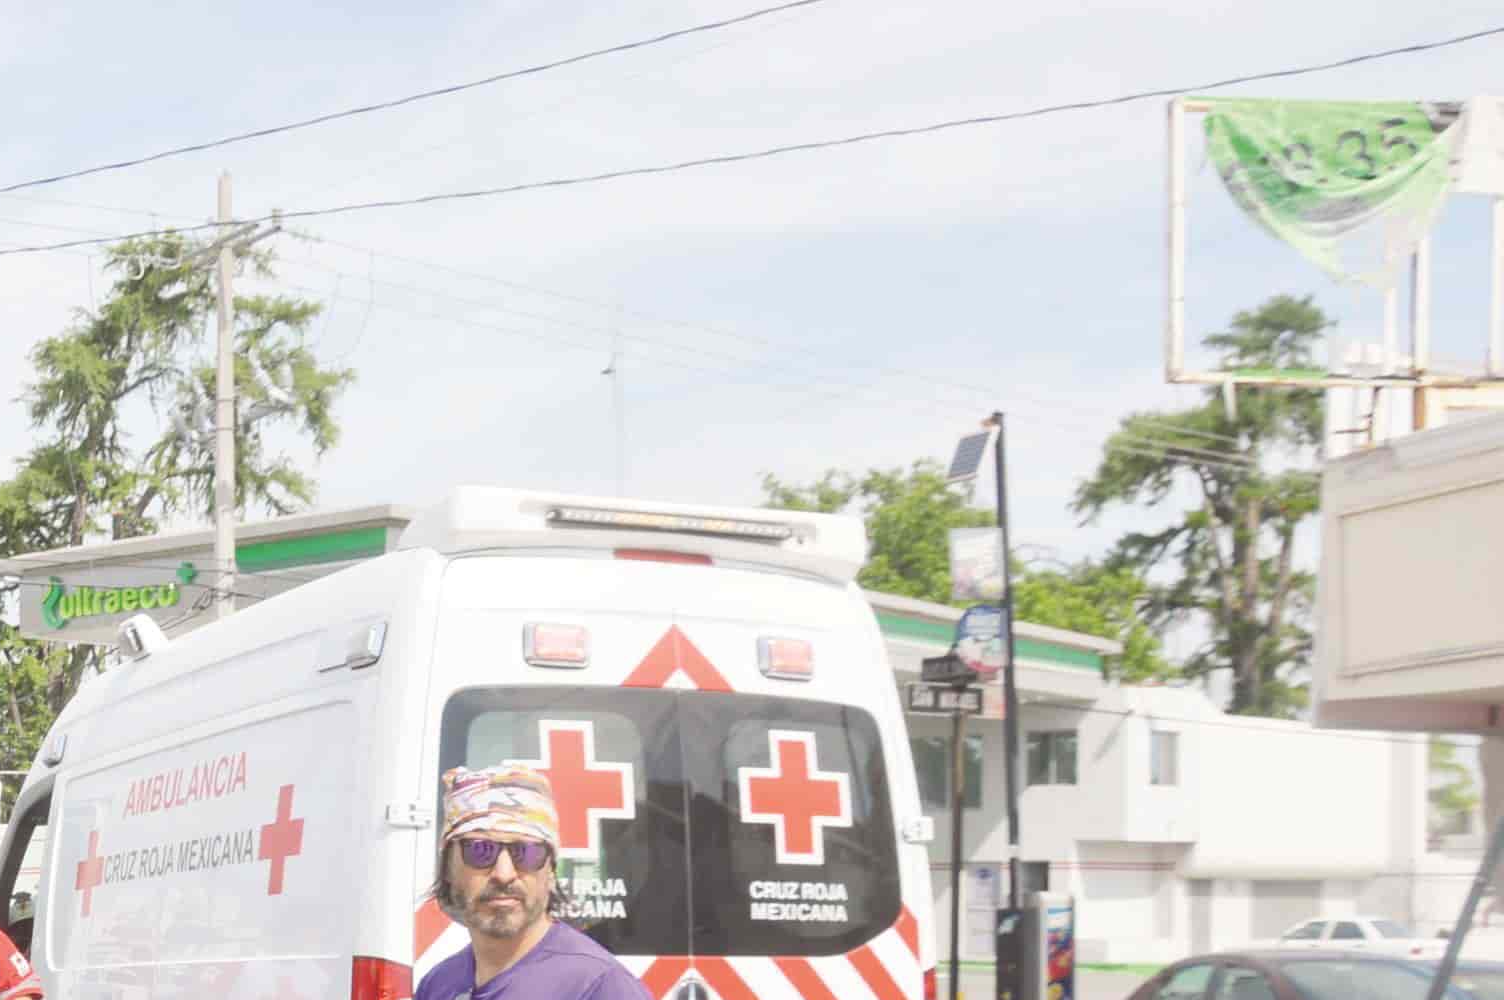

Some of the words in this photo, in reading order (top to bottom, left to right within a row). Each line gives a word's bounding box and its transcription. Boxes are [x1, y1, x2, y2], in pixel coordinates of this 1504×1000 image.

[59, 584, 180, 619] ultraeco
[122, 751, 248, 820] AMBULANCIA
[104, 849, 138, 884] CRUZ
[139, 843, 175, 880] ROJA
[176, 829, 254, 873] MEXICANA
[749, 880, 800, 900] CRUZ
[800, 882, 848, 901] ROJA
[750, 902, 848, 921] MEXICANA
